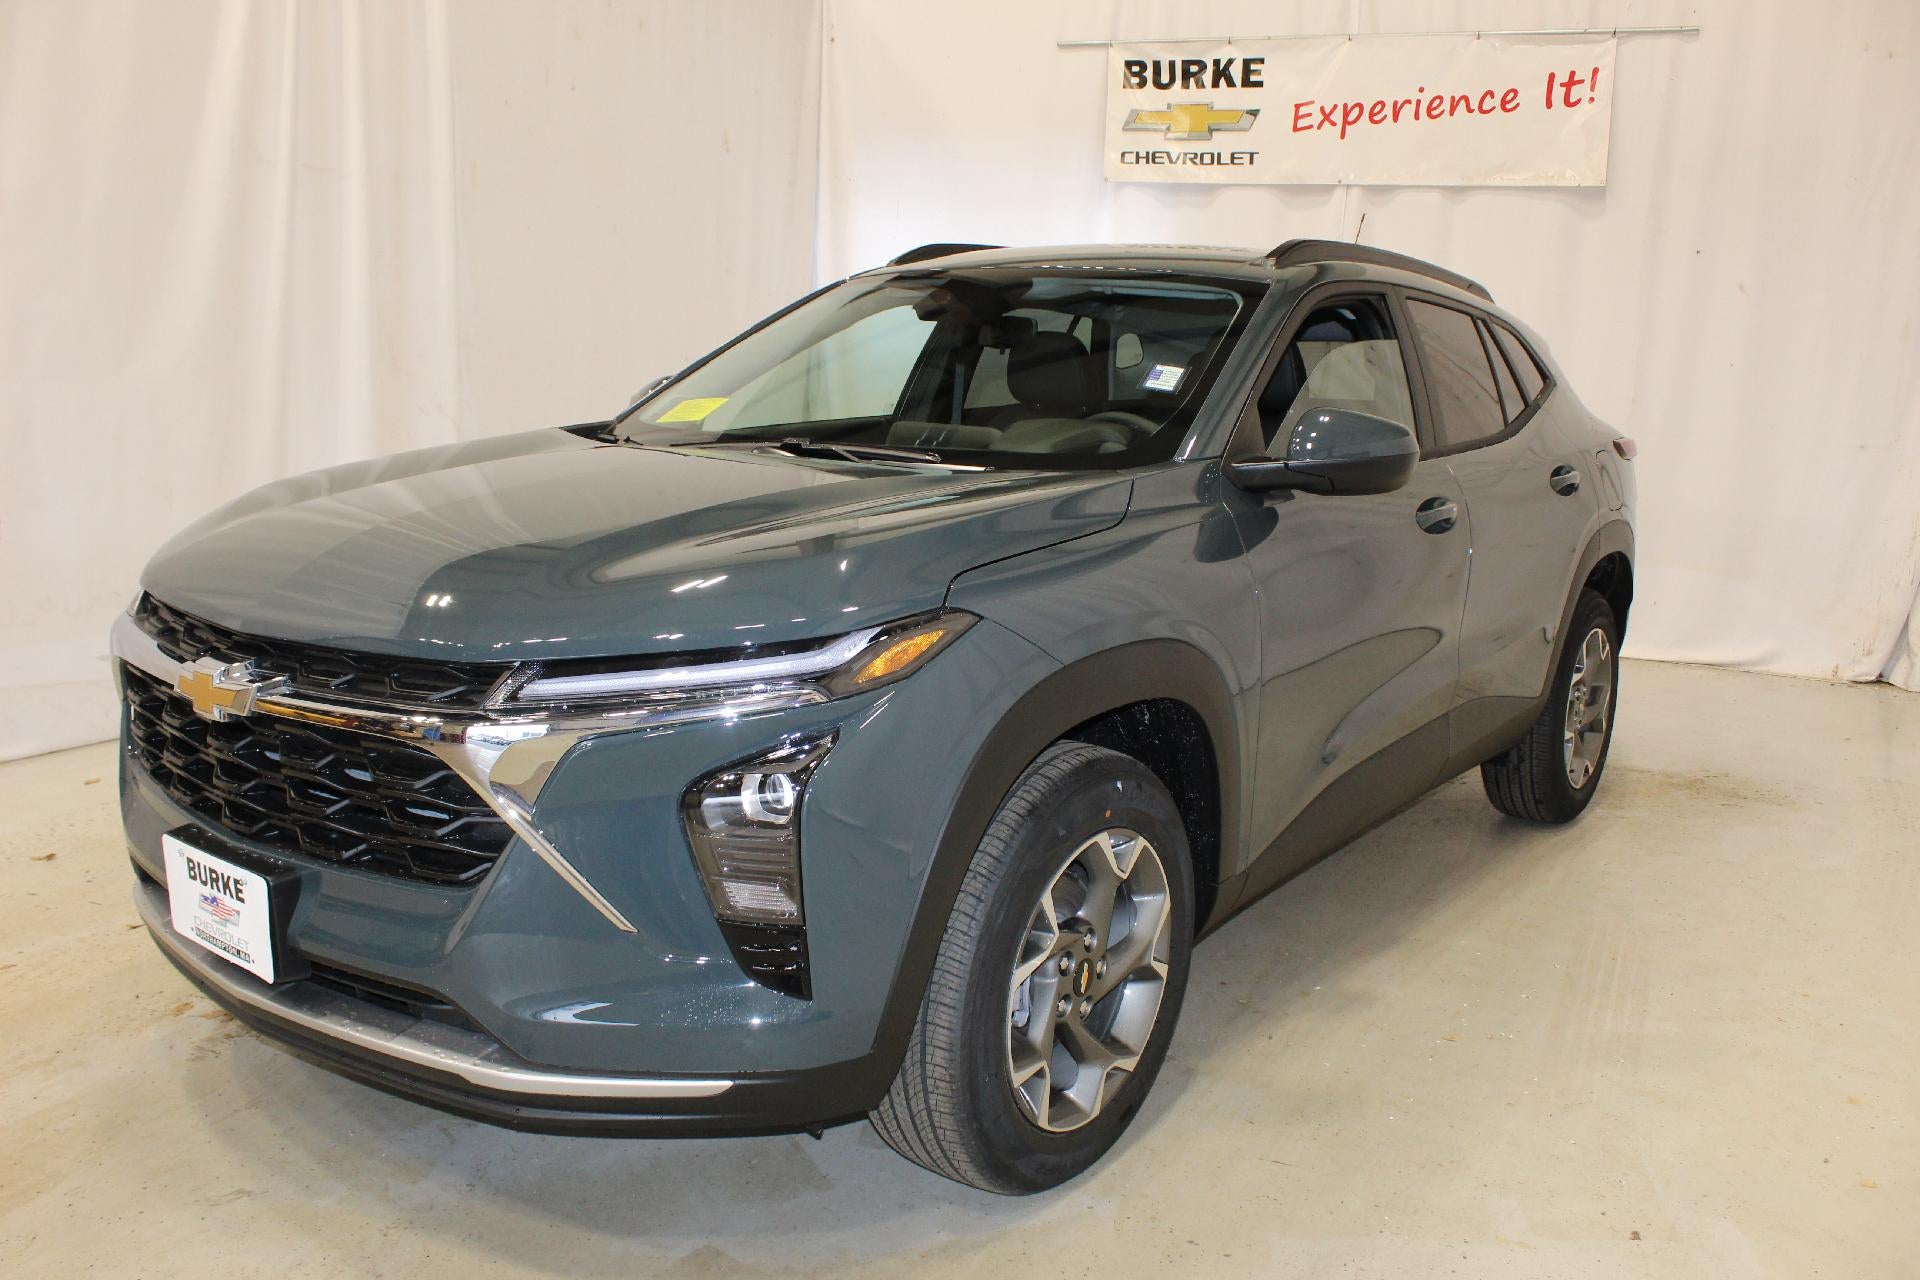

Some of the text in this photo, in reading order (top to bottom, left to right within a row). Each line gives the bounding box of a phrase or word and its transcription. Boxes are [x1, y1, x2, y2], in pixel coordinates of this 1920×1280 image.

[1122, 57, 1265, 90] BURKE
[1292, 66, 1600, 140] Experience It!
[1120, 151, 1259, 166] CHEVROLET
[187, 857, 246, 904] BURKE
[194, 915, 249, 951] CHEVROLET
